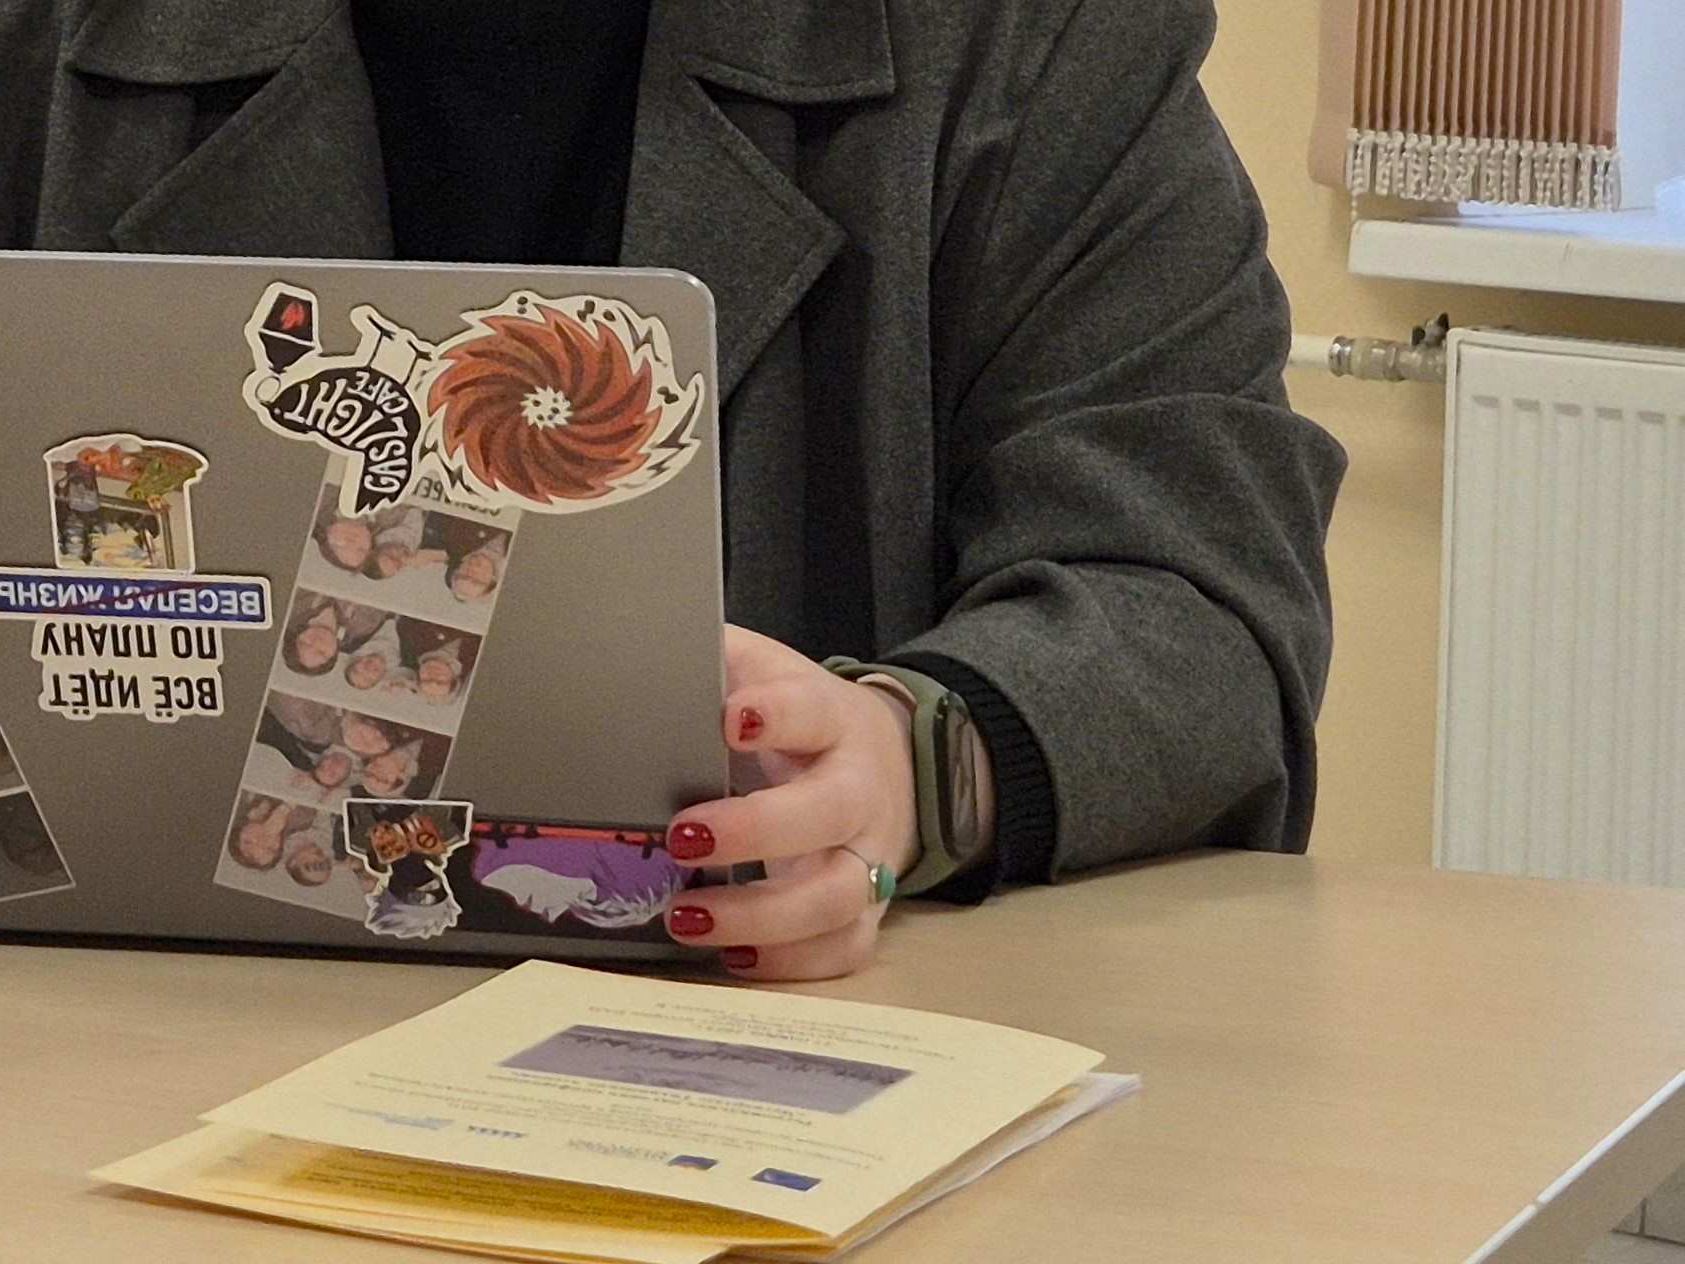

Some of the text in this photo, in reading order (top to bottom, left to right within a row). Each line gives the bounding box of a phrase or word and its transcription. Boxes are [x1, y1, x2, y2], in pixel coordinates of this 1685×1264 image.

[346, 370, 408, 413] CAFE
[283, 378, 407, 492] GASLIGHT
[112, 584, 260, 614] ВЕСЕЛАЯ
[39, 622, 216, 658] ПО ПЛАНУ
[48, 667, 218, 717] ВСЁ ИДЁТ
